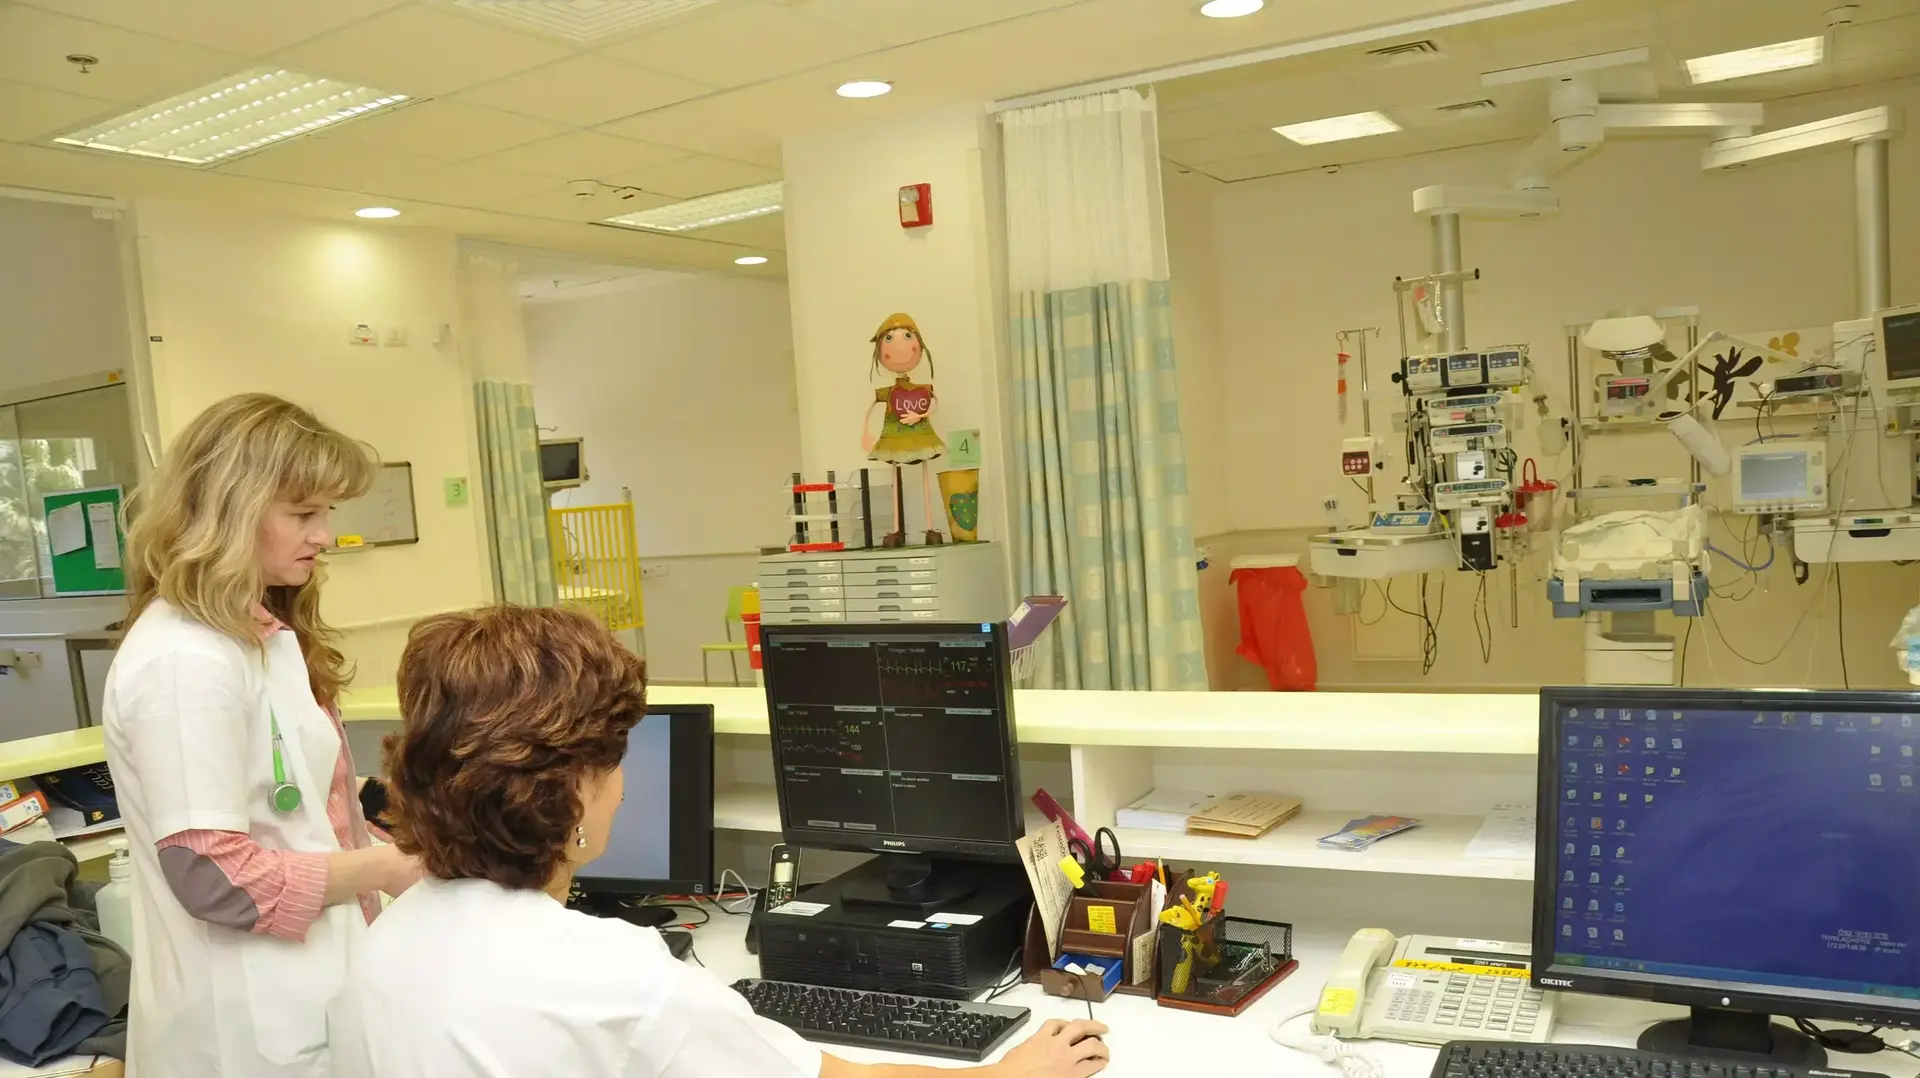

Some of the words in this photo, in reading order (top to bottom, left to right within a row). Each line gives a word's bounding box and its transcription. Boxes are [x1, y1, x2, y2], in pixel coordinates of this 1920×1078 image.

[896, 398, 928, 411] Love
[959, 438, 969, 454] 4
[452, 483, 461, 497] 3
[951, 661, 966, 671] 117
[845, 724, 860, 734] 144
[1540, 978, 1573, 987] OKITEC
[1808, 1069, 1852, 1078] Microsoft
